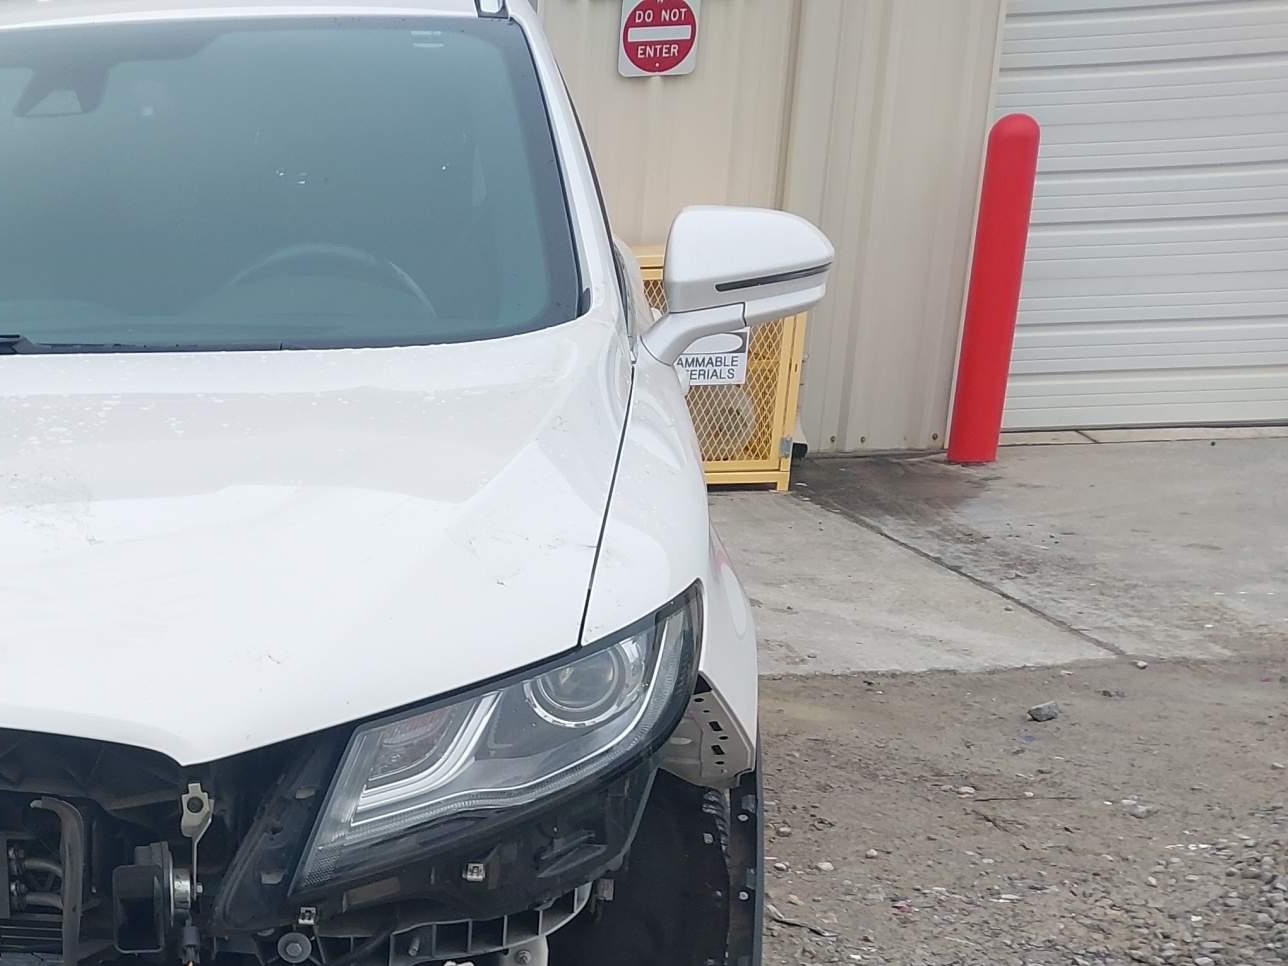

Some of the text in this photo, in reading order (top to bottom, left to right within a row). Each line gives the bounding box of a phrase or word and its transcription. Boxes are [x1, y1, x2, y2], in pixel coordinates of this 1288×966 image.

[635, 8, 688, 23] DO NOT
[637, 44, 679, 58] ENTER
[686, 368, 735, 381] ERIALS
